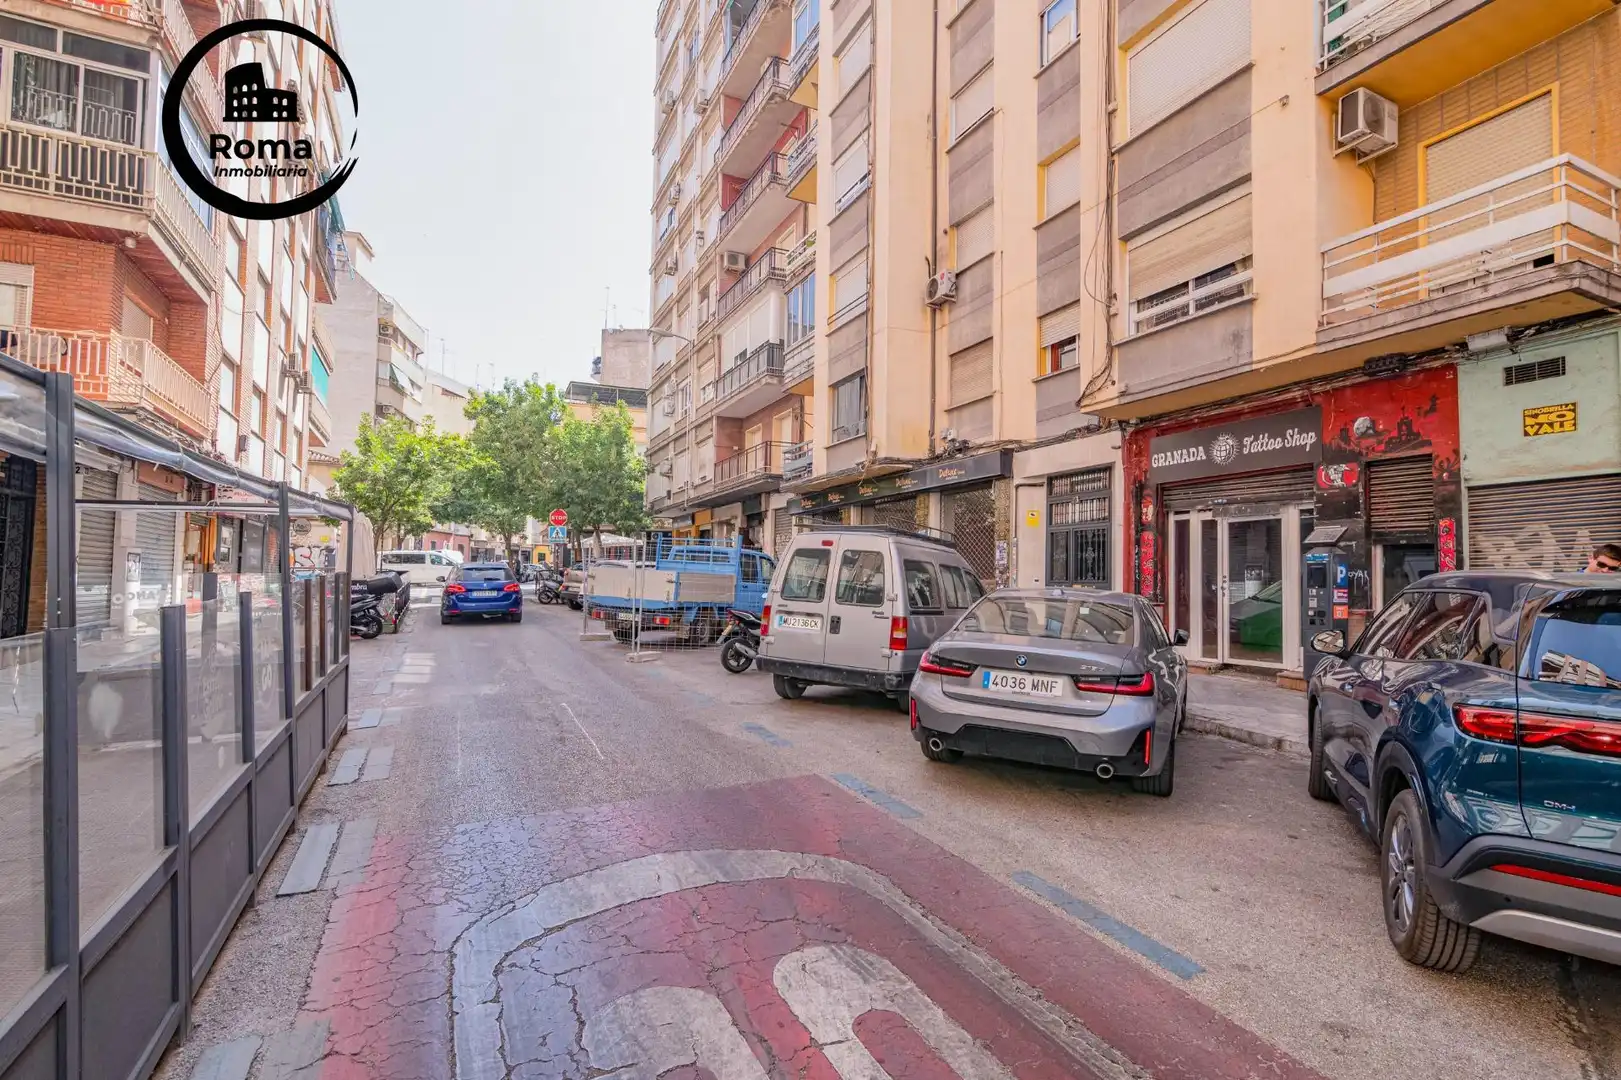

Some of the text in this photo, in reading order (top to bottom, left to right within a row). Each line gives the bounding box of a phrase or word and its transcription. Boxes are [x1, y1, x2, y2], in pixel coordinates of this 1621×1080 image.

[1525, 410, 1575, 425] NO
[1524, 420, 1576, 436] VALE
[1151, 427, 1318, 468] GRANADA Tattoo Shop
[1336, 565, 1347, 584] P
[991, 674, 1059, 693] 4036 MNF
